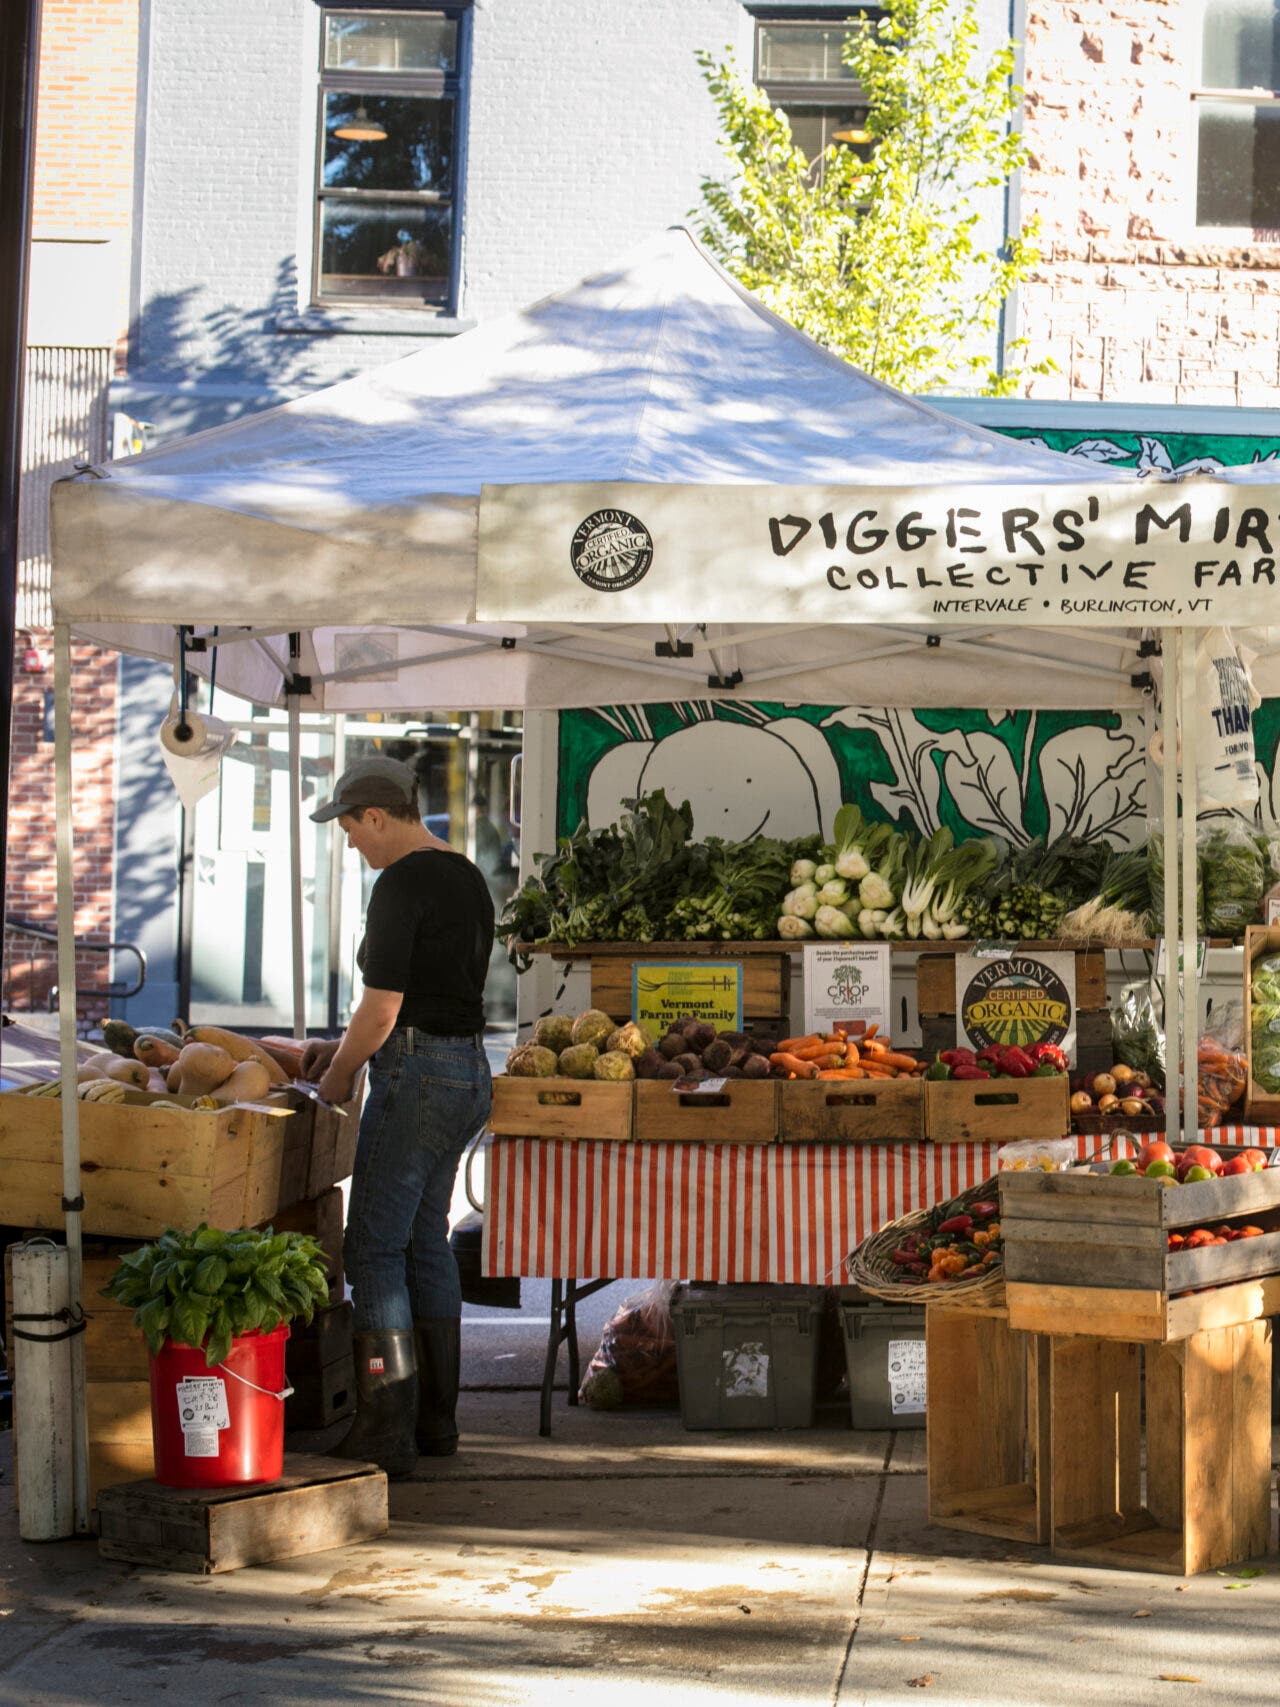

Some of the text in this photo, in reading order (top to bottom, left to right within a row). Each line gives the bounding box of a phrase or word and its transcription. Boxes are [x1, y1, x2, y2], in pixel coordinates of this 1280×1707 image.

[574, 511, 635, 543] VERMONT
[768, 496, 1099, 556] DIGGERS'
[587, 528, 628, 549] CERTIFIED
[578, 535, 645, 568] ORGANIC
[827, 560, 1155, 590] COLLECTIVE
[933, 597, 1213, 615] INTERVALE BURLINGTON, VT
[973, 960, 1058, 987] VERMONT
[827, 985, 869, 997] CROP
[989, 990, 1044, 1000] CERTIFIED
[661, 1000, 714, 1008] Vermont
[970, 1001, 1062, 1020] ORGANIC
[640, 1010, 735, 1022] Farm to Family
